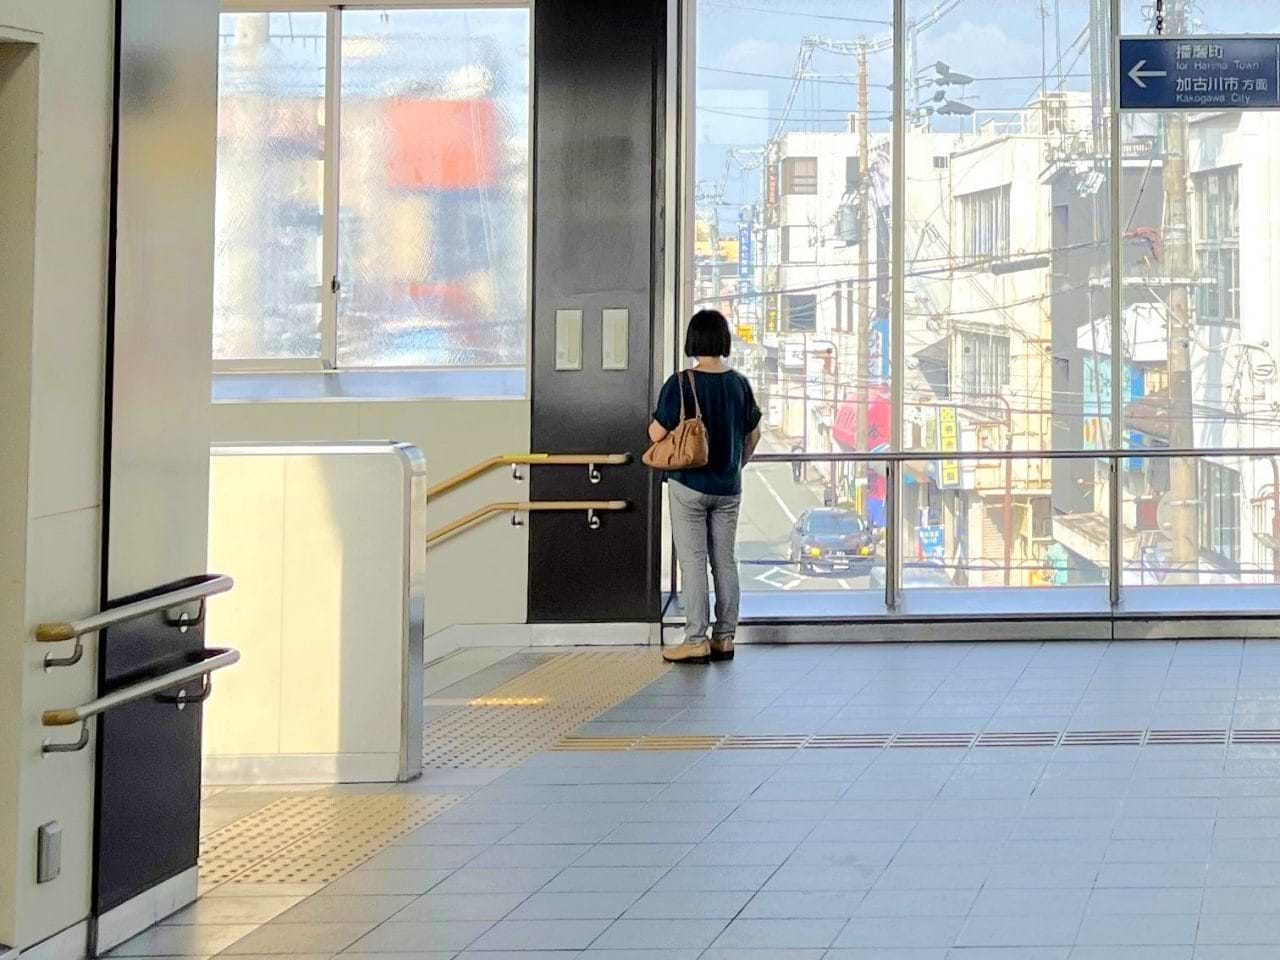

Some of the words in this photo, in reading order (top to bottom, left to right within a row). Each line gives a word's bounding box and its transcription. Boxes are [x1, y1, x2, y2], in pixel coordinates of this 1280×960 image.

[1234, 60, 1259, 70] Town
[1176, 93, 1226, 105] Kakogawa
[1231, 92, 1251, 105] City
